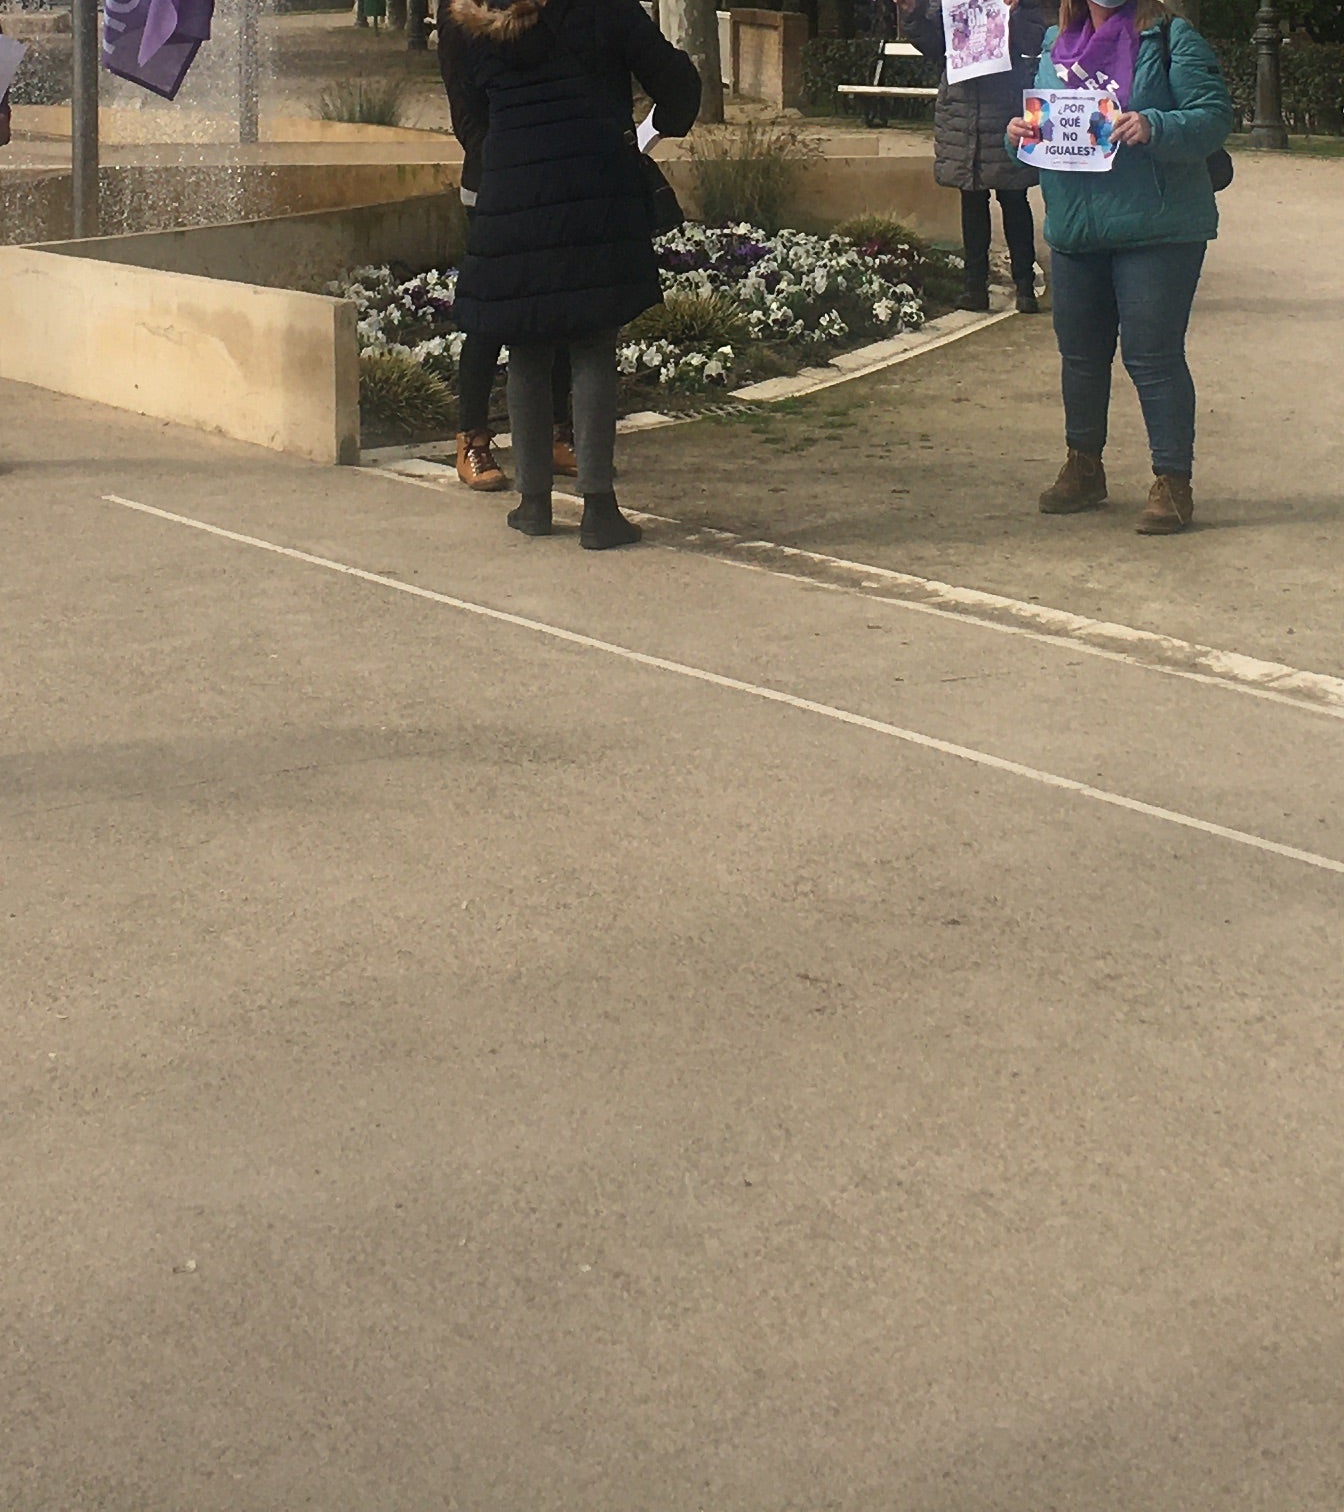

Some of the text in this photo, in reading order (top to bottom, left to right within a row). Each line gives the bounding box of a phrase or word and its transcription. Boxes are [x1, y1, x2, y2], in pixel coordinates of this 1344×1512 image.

[1057, 103, 1085, 115] ¿POR
[1059, 116, 1081, 128] QUÉ
[1062, 132, 1078, 142] NO
[1045, 146, 1096, 156] IGUALES?
